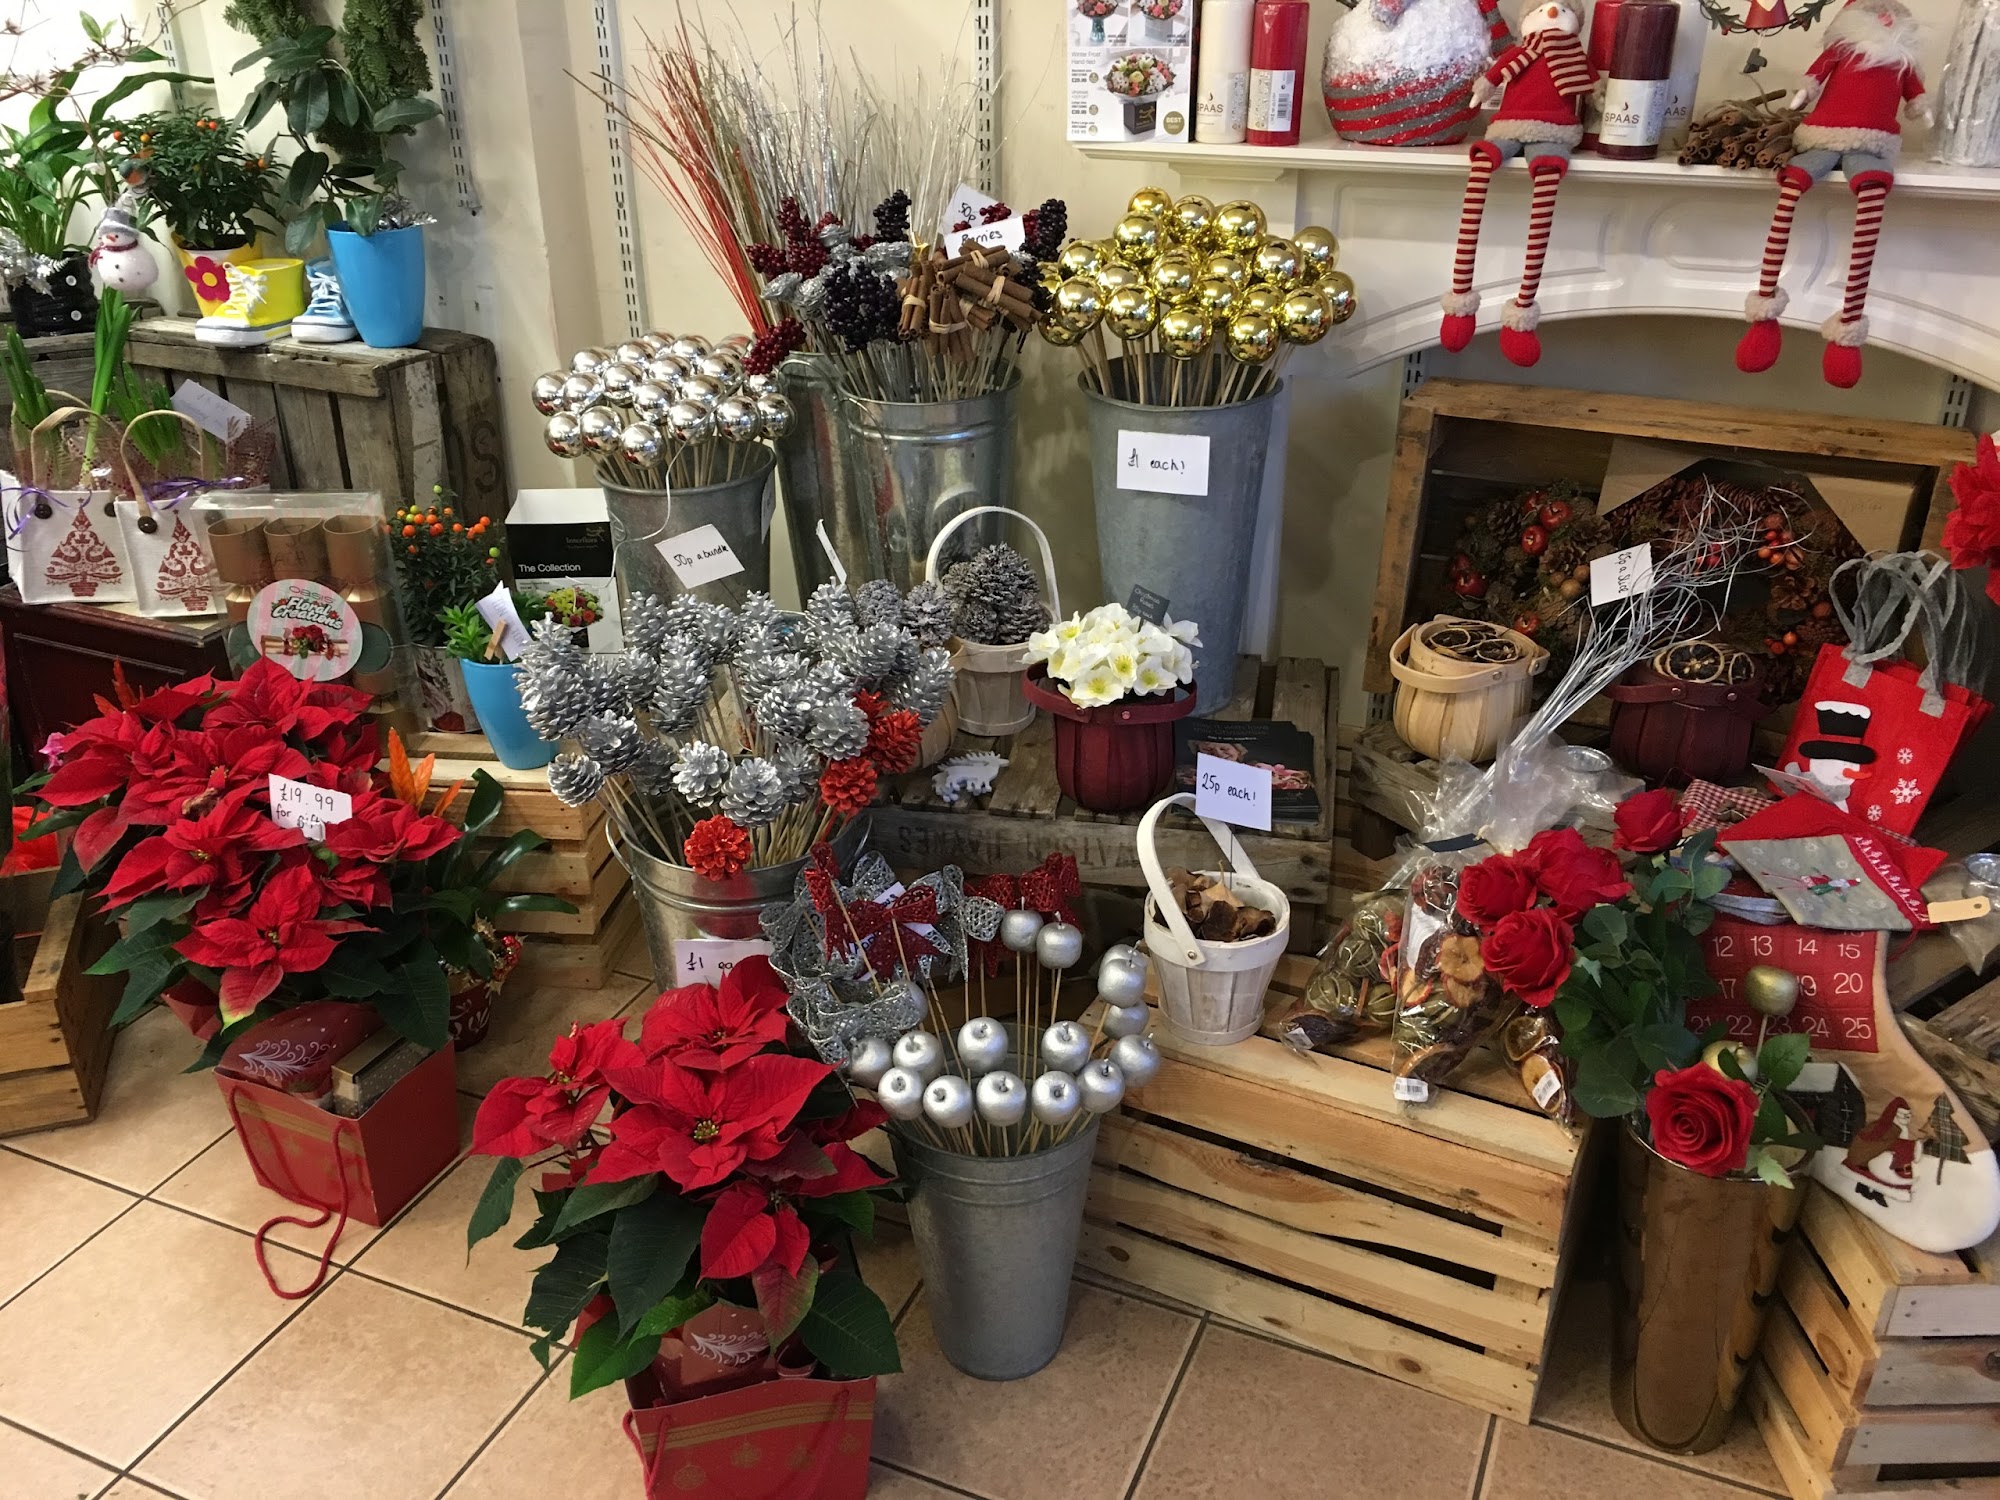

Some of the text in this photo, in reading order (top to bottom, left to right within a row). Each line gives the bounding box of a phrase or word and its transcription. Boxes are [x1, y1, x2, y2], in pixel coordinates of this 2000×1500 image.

[1605, 112, 1640, 124] SPAAS
[1664, 106, 1687, 116] AAS
[1150, 459, 1185, 475] each!
[518, 563, 581, 573] The Collection
[673, 553, 694, 568] 50p
[286, 596, 332, 616] Floral
[271, 604, 343, 630] Creations
[1201, 772, 1256, 806] 25p each!
[276, 803, 292, 819] for
[1711, 935, 1861, 959] 12 13 14 15
[1718, 978, 1736, 1000] 17
[1833, 972, 1863, 994] 20
[1726, 1014, 1753, 1036] 22
[1765, 1015, 1792, 1035] 23
[1802, 1016, 1830, 1038] 24
[1842, 1017, 1871, 1039] 25
